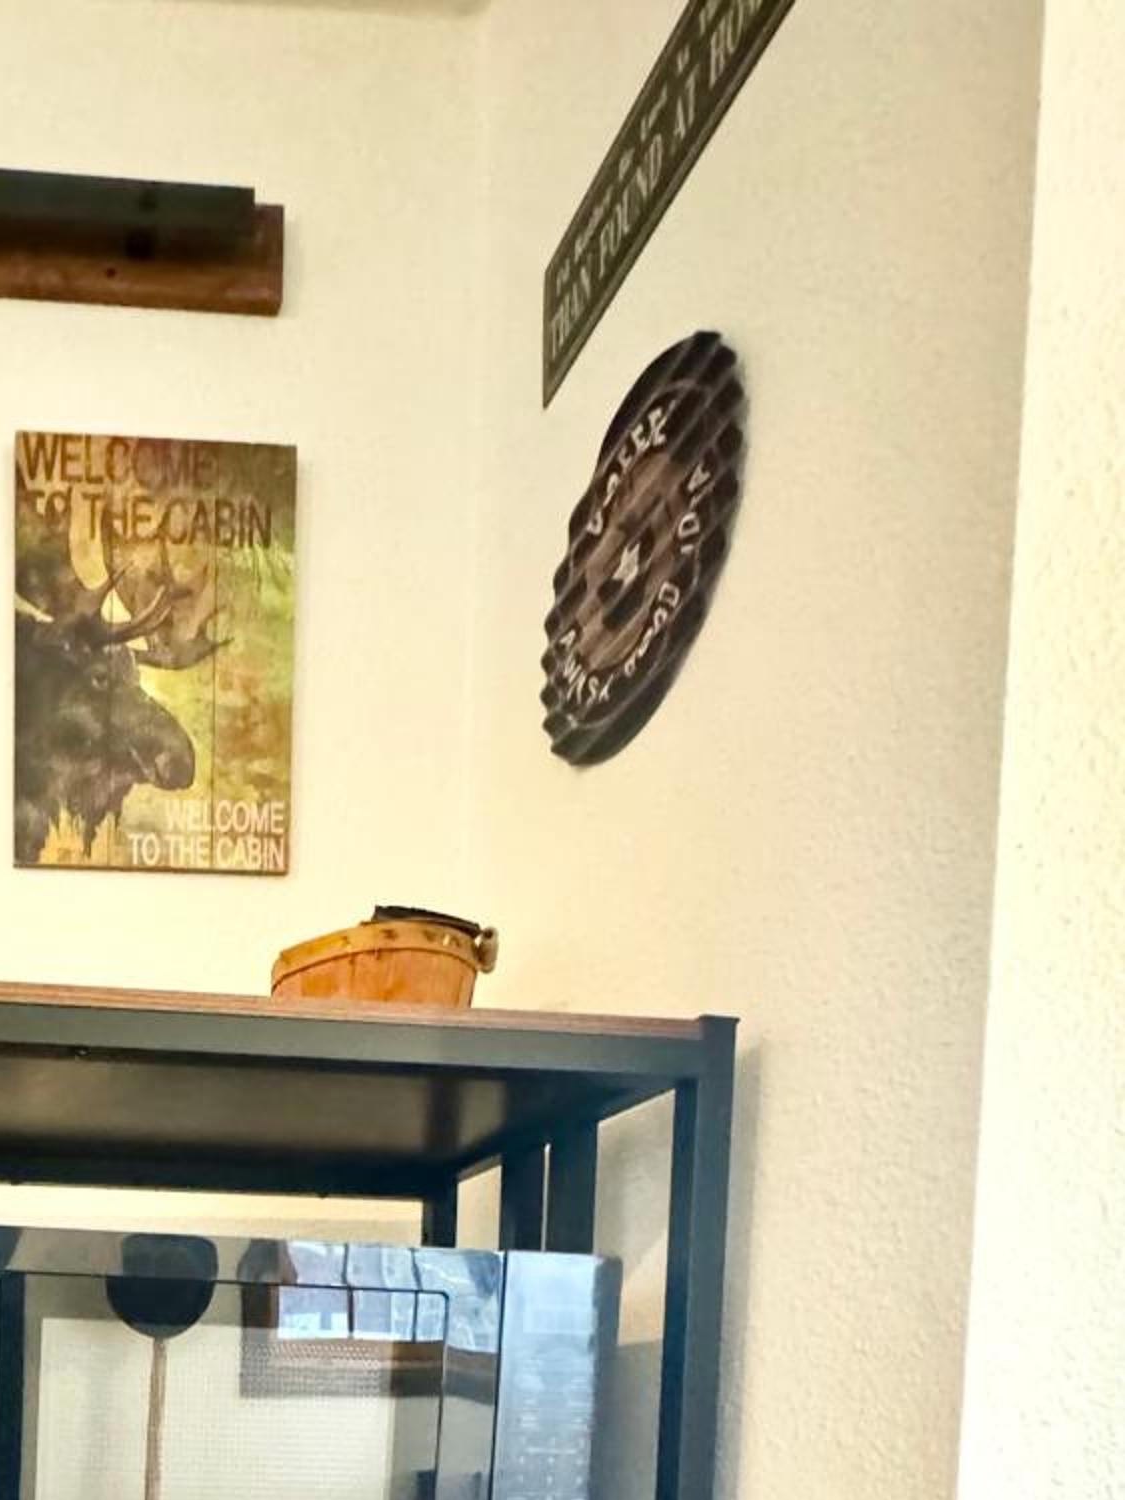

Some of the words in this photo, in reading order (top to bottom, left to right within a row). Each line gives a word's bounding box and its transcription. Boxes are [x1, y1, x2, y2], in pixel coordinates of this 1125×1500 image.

[22, 431, 217, 491] WELCOME
[25, 486, 73, 534] TO
[81, 489, 156, 543] THE
[159, 496, 273, 549] CABIN
[165, 798, 284, 834] WELCOME
[127, 831, 161, 866] TO
[164, 833, 211, 869] THE
[216, 835, 285, 872] CABIN
